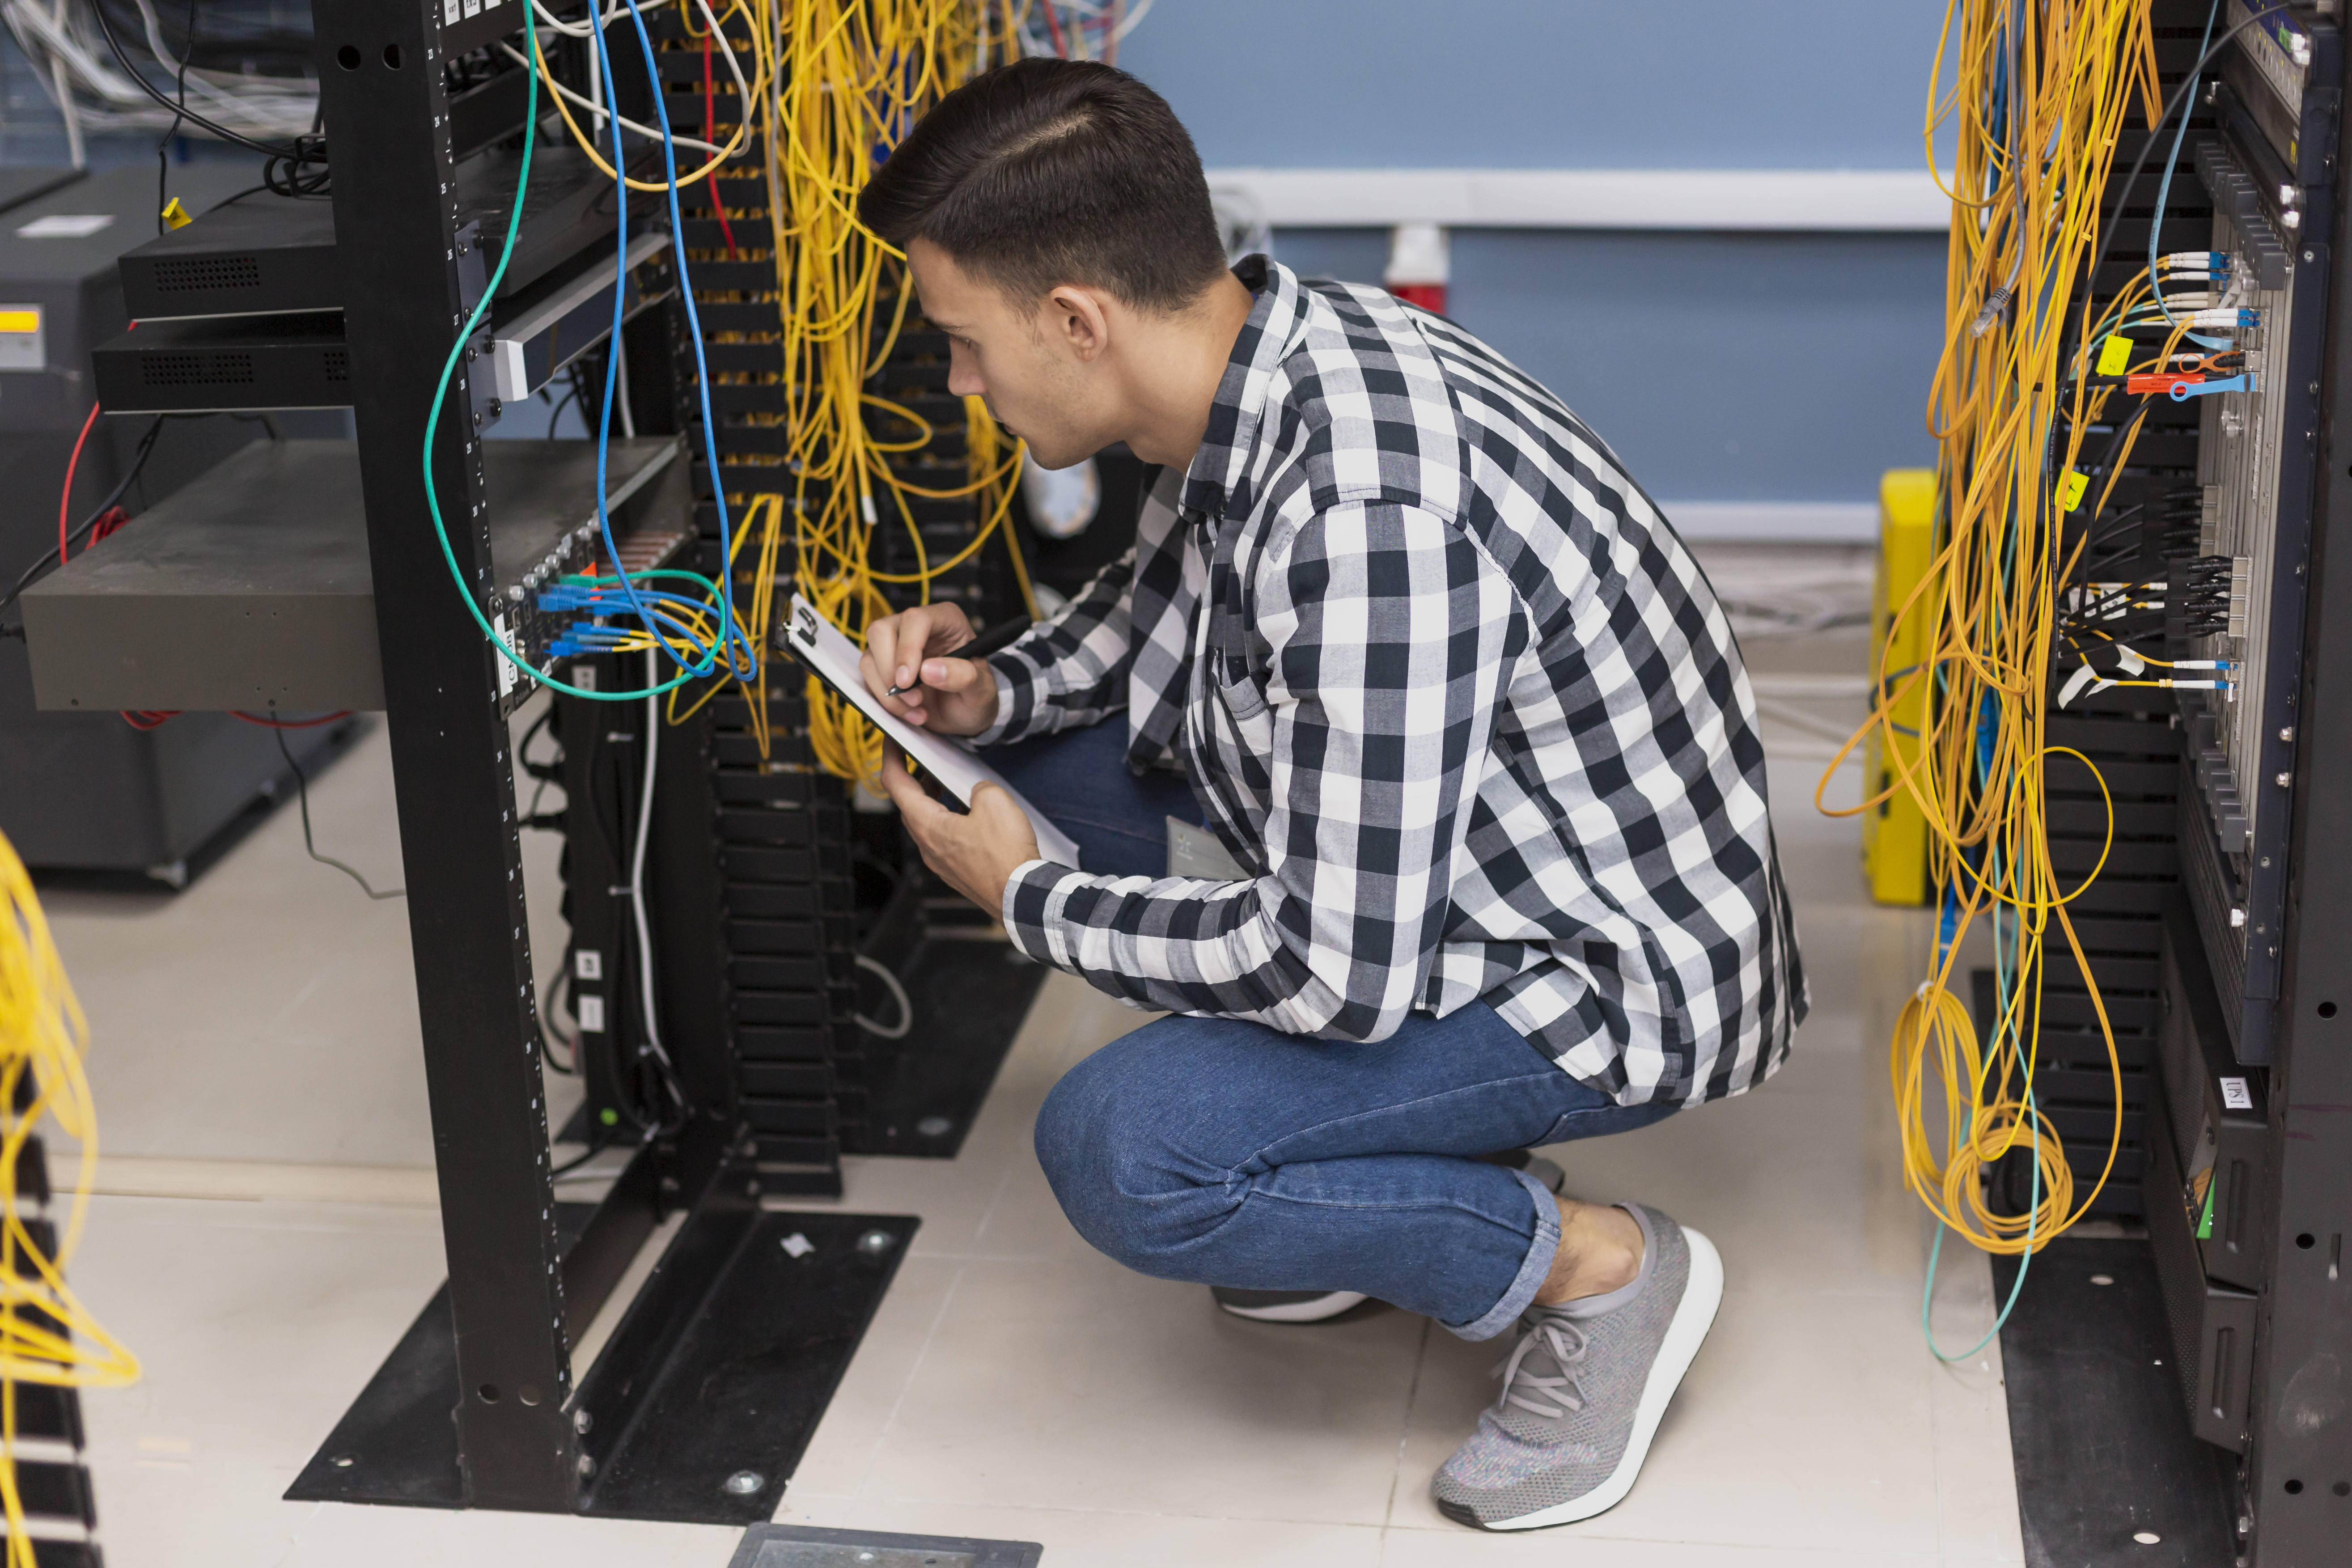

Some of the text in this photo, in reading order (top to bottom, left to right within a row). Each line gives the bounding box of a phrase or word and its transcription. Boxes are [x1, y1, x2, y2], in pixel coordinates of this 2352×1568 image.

[428, 48, 433, 60] 23
[434, 115, 440, 128] 24
[2226, 1082, 2244, 1098] UPS
